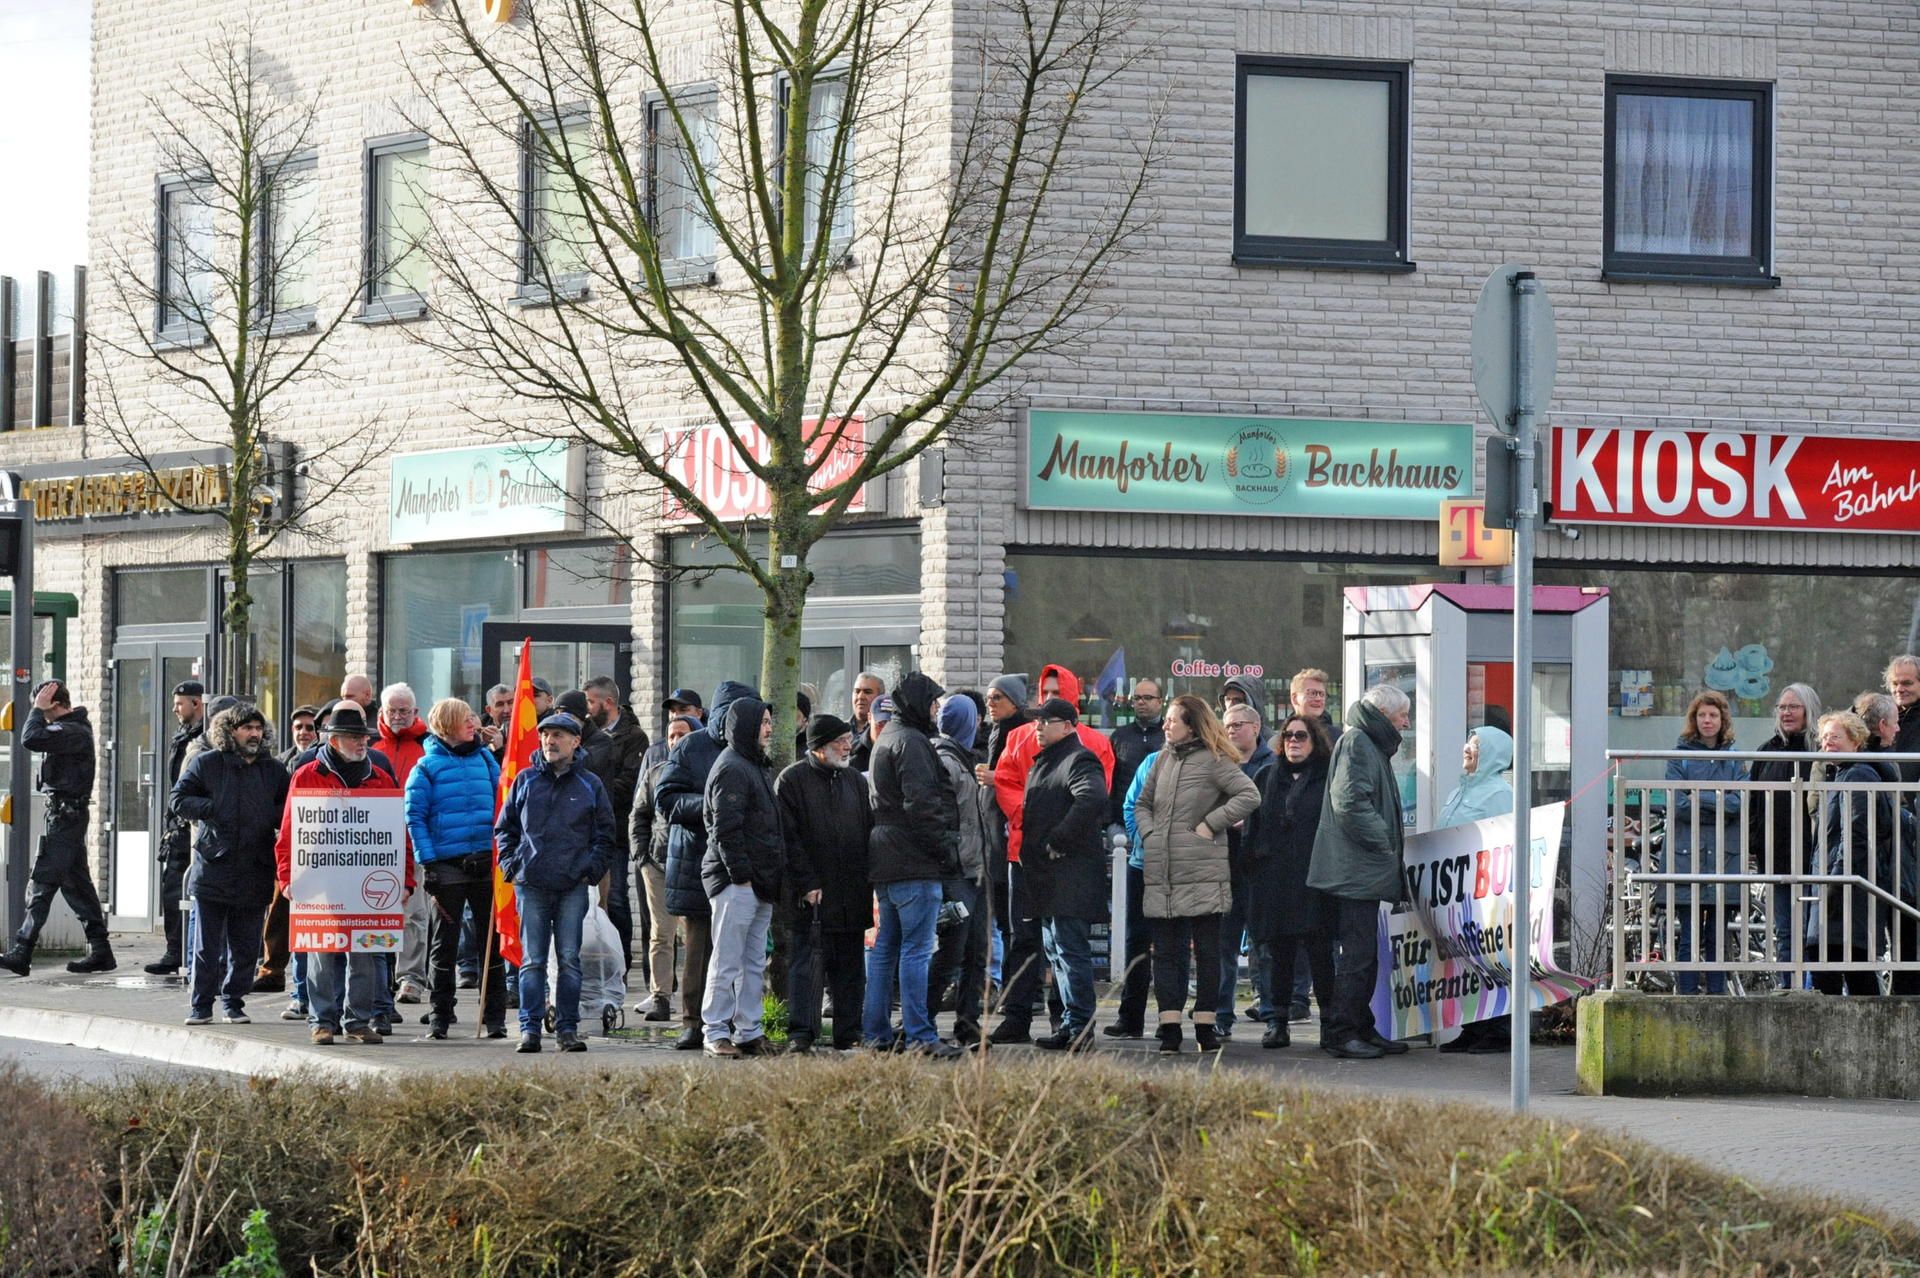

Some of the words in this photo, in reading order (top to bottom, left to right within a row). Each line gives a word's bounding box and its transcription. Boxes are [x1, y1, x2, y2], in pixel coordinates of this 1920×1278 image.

[1239, 428, 1277, 445] Manforter
[1038, 433, 1210, 494] Manforter
[1304, 444, 1464, 491] Backhaus
[1560, 427, 1807, 519] KIOSK
[1822, 460, 1873, 494] Am
[395, 476, 461, 525] Manforter
[498, 468, 561, 509] Backhaus
[1235, 484, 1279, 493] BACKHAUS
[1450, 506, 1485, 560] T
[1171, 658, 1220, 677] Coffee
[1222, 661, 1240, 677] to
[1243, 665, 1263, 678] go
[297, 806, 339, 824] Verbot
[342, 806, 370, 824] aller
[297, 827, 392, 845] faschistischen
[297, 849, 398, 869] Organisationen!
[1430, 854, 1470, 908] IST
[1473, 836, 1547, 899] BUT
[295, 902, 346, 912] Konsequent.
[295, 918, 378, 927] Internationalistische
[380, 918, 400, 927] Liste
[295, 932, 348, 949] MLPD
[1390, 930, 1432, 971] Für
[1393, 969, 1480, 1010] tolerante
